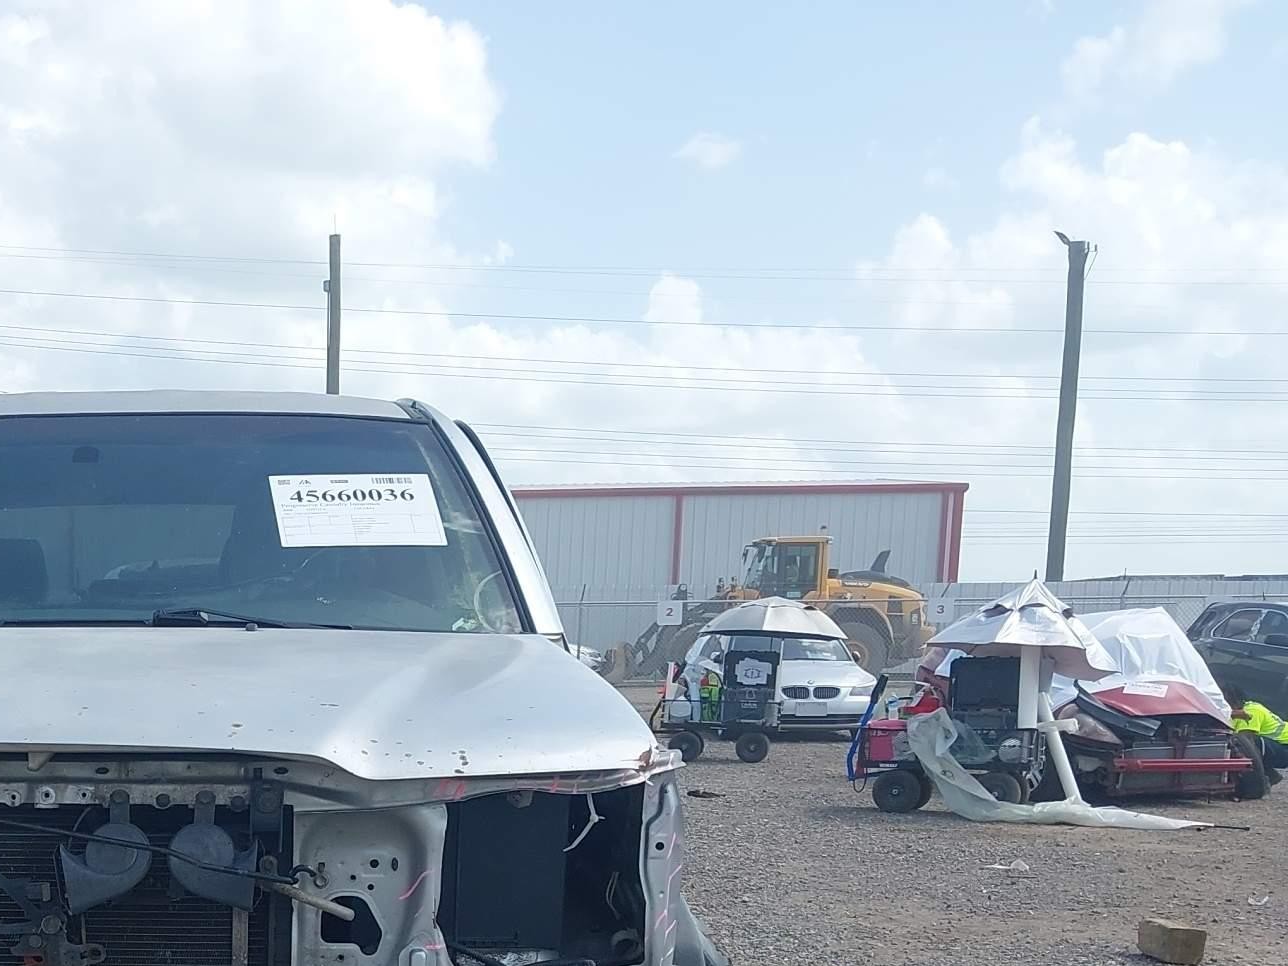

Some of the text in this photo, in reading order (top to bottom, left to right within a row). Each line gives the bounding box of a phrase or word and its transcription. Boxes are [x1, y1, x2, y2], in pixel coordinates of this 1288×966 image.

[290, 488, 415, 503] 45660036
[665, 607, 674, 617] 2
[936, 604, 945, 614] 3
